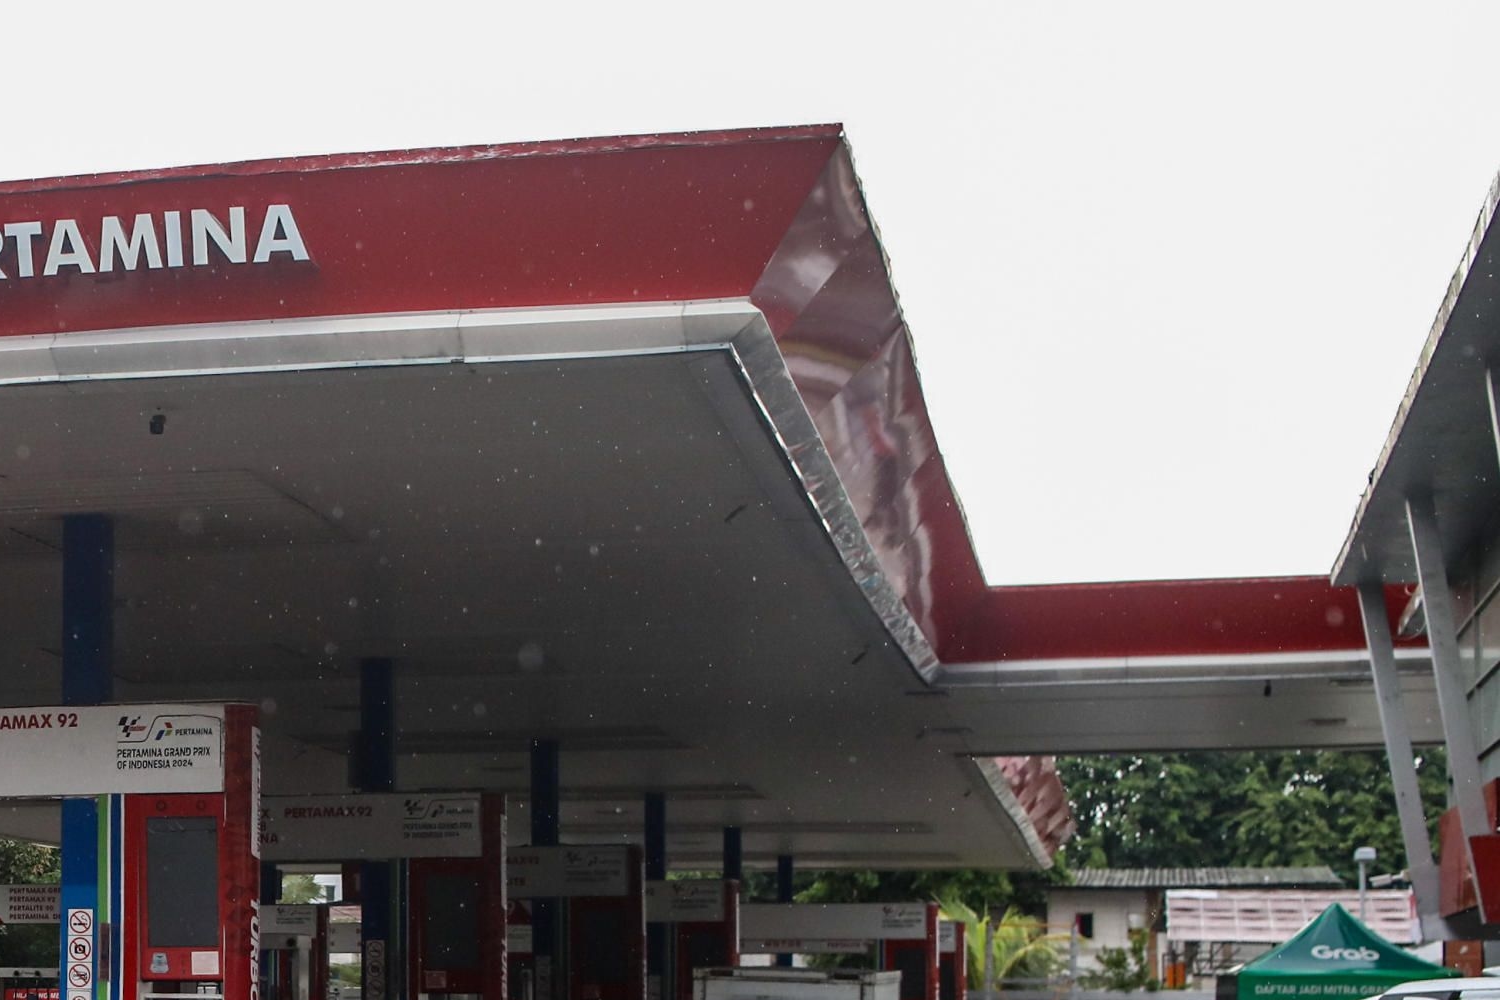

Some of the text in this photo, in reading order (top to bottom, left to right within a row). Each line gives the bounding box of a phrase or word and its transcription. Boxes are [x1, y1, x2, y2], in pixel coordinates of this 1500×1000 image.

[57, 713, 78, 728] 92
[175, 728, 213, 736] PERTAMINA
[117, 746, 211, 758] PERTAMINA GRAND PRIX
[117, 759, 193, 770] OF INDONESIA 2024
[284, 805, 373, 819] PERTAMAX 92
[1311, 944, 1380, 962] Grab
[1255, 984, 1296, 995] DAFTAR
[1299, 984, 1321, 995] JADI
[1323, 985, 1357, 995] MITRA
